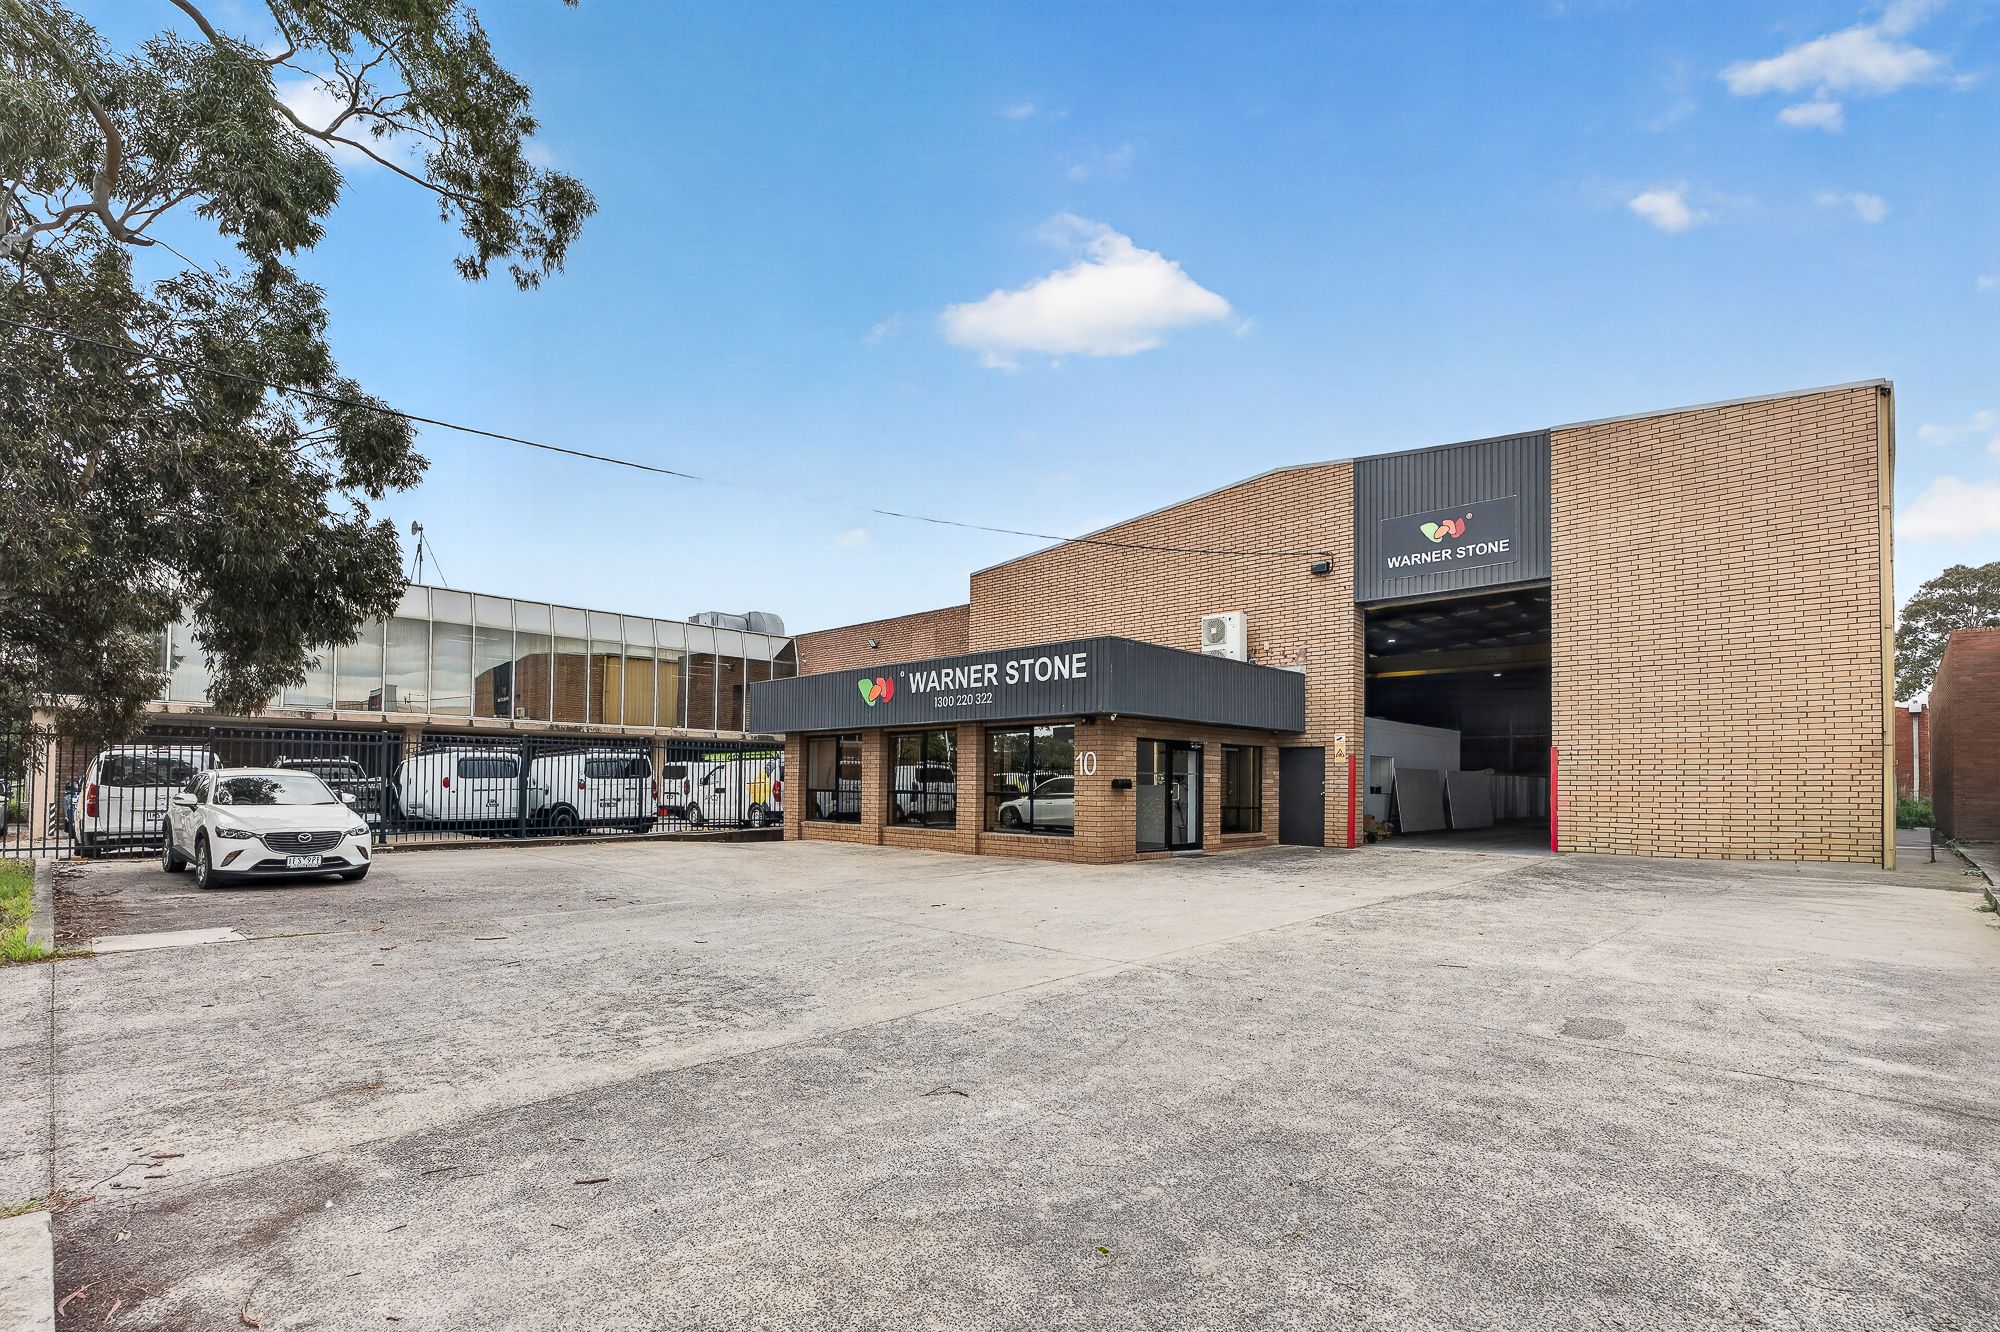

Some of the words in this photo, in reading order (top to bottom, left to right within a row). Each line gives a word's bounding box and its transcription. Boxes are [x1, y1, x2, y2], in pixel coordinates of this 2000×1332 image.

[1387, 548, 1452, 568] WARNER
[1456, 539, 1510, 559] STONE
[909, 663, 998, 694] WARNER
[1005, 652, 1087, 685] STONE
[934, 696, 954, 708] 1300
[956, 694, 973, 706] 220
[975, 692, 992, 705] 322
[1075, 751, 1096, 776] 10
